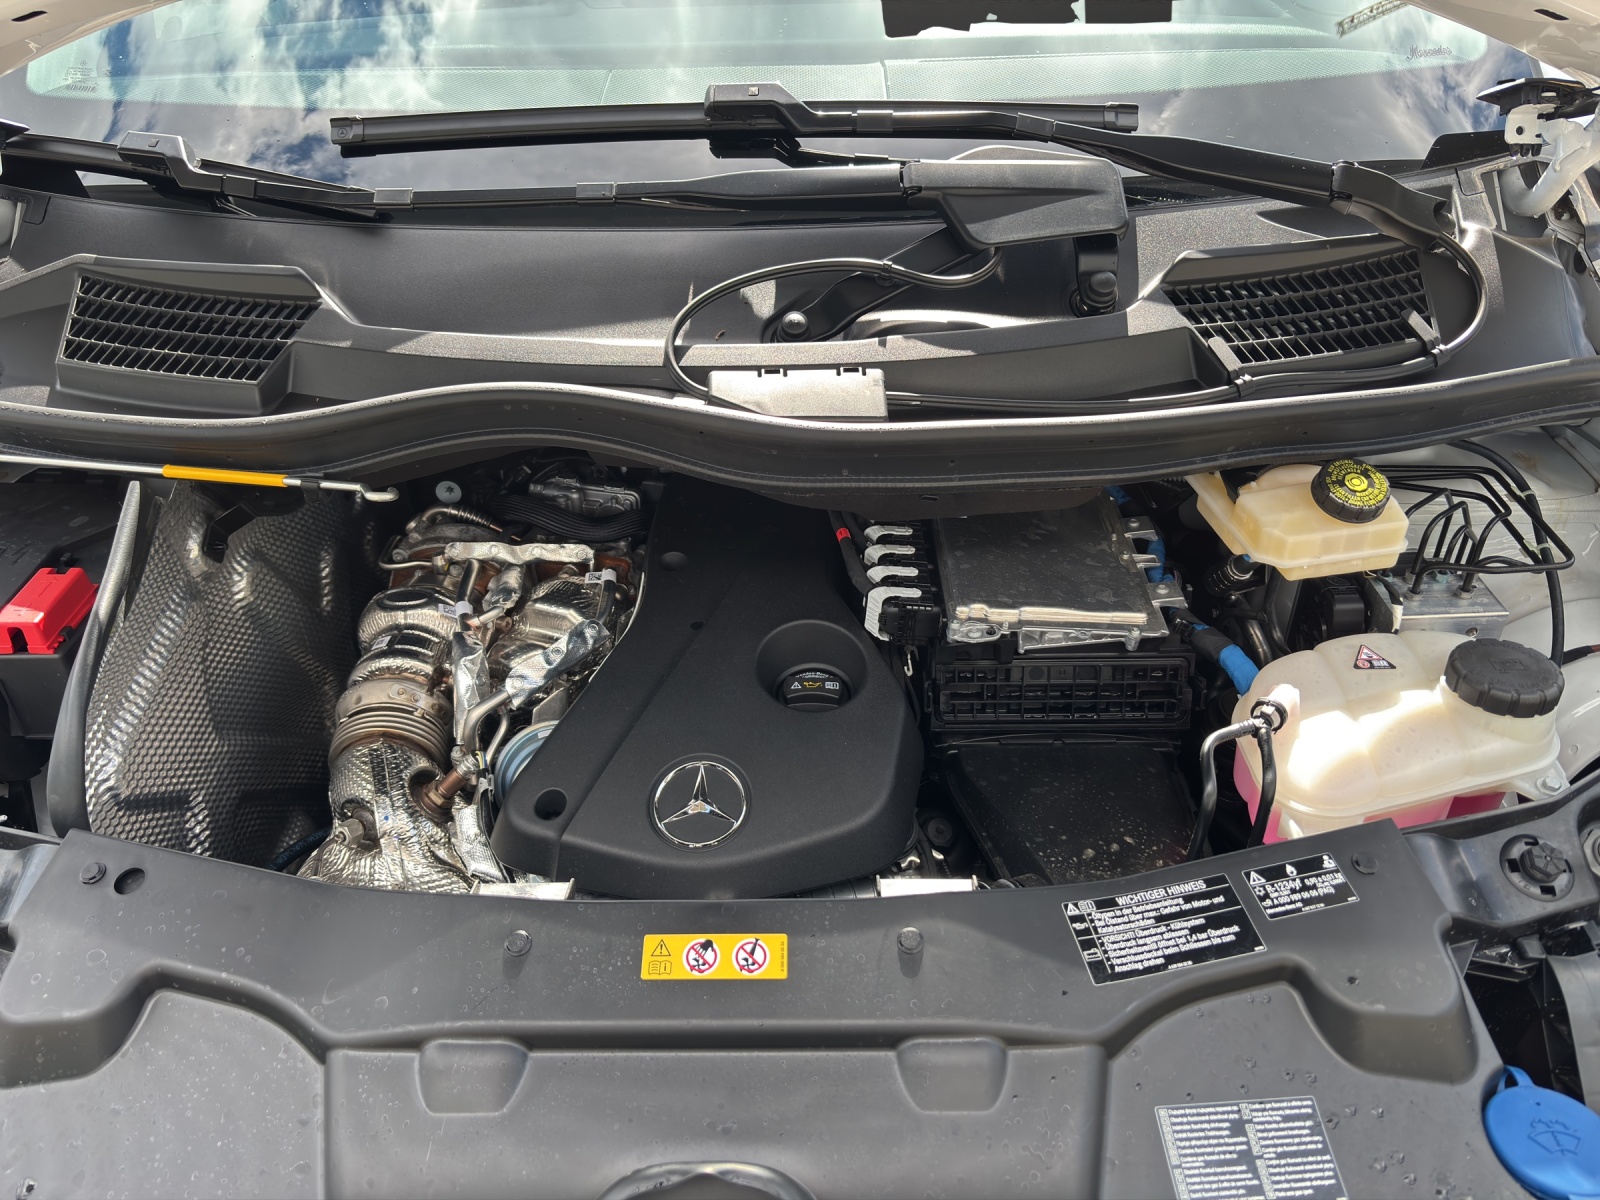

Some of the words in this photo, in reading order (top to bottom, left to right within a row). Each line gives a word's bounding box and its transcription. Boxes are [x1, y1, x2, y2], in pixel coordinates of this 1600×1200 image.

[1406, 45, 1452, 60] Mercedes
[1116, 889, 1167, 905] WICHTIGER
[1167, 880, 1206, 895] HINWEIS
[1265, 877, 1302, 893] R-1234yf
[1160, 906, 1180, 914] Gefahr
[1192, 899, 1212, 908] Motor-
[1212, 895, 1224, 903] und
[1143, 958, 1165, 967] drehen
